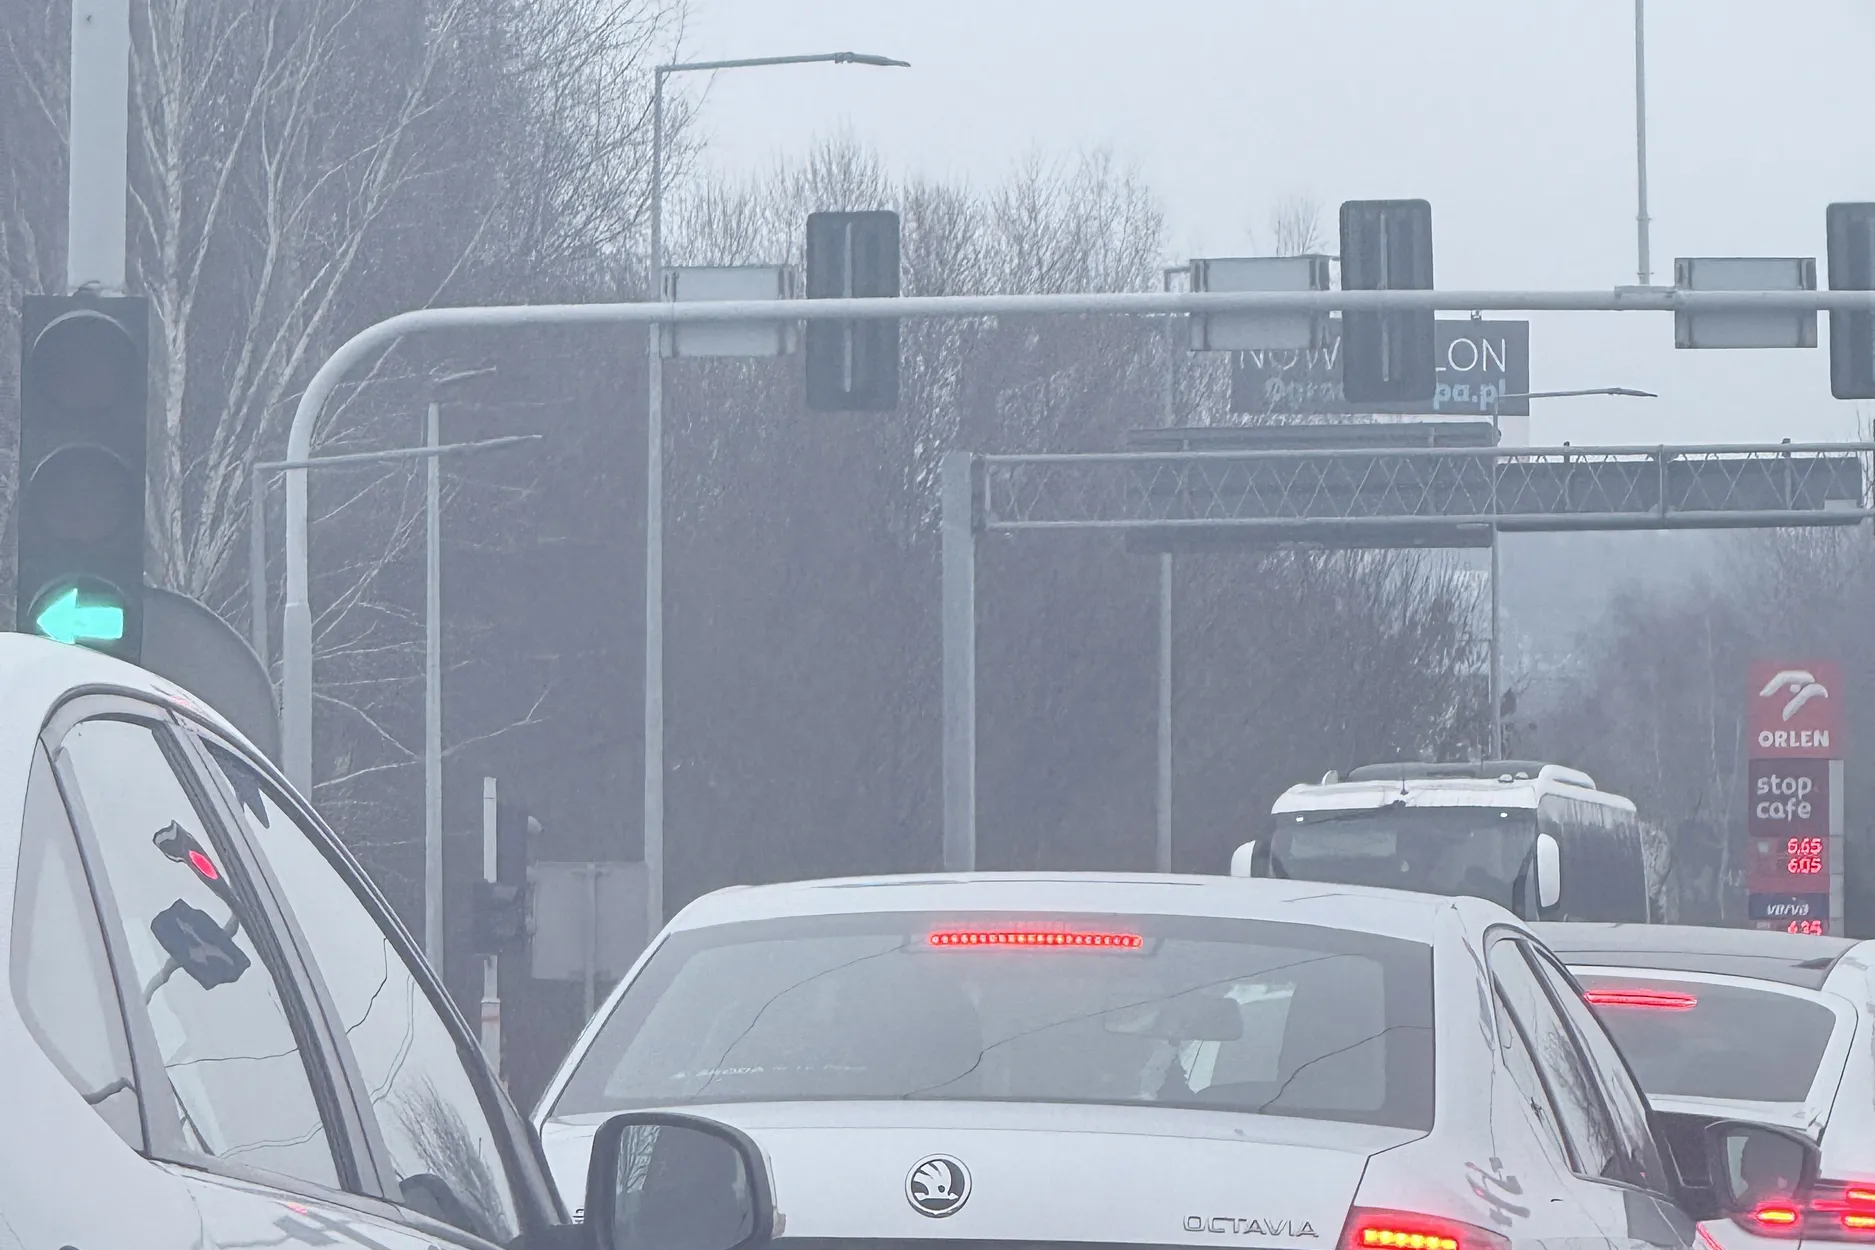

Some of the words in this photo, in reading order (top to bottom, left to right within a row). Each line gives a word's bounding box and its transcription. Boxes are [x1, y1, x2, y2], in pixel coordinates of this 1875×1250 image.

[1758, 730, 1829, 747] ORLEN
[1757, 774, 1812, 800] stop
[1756, 798, 1811, 821] cafe
[1183, 1215, 1319, 1238] OCTAVIA
